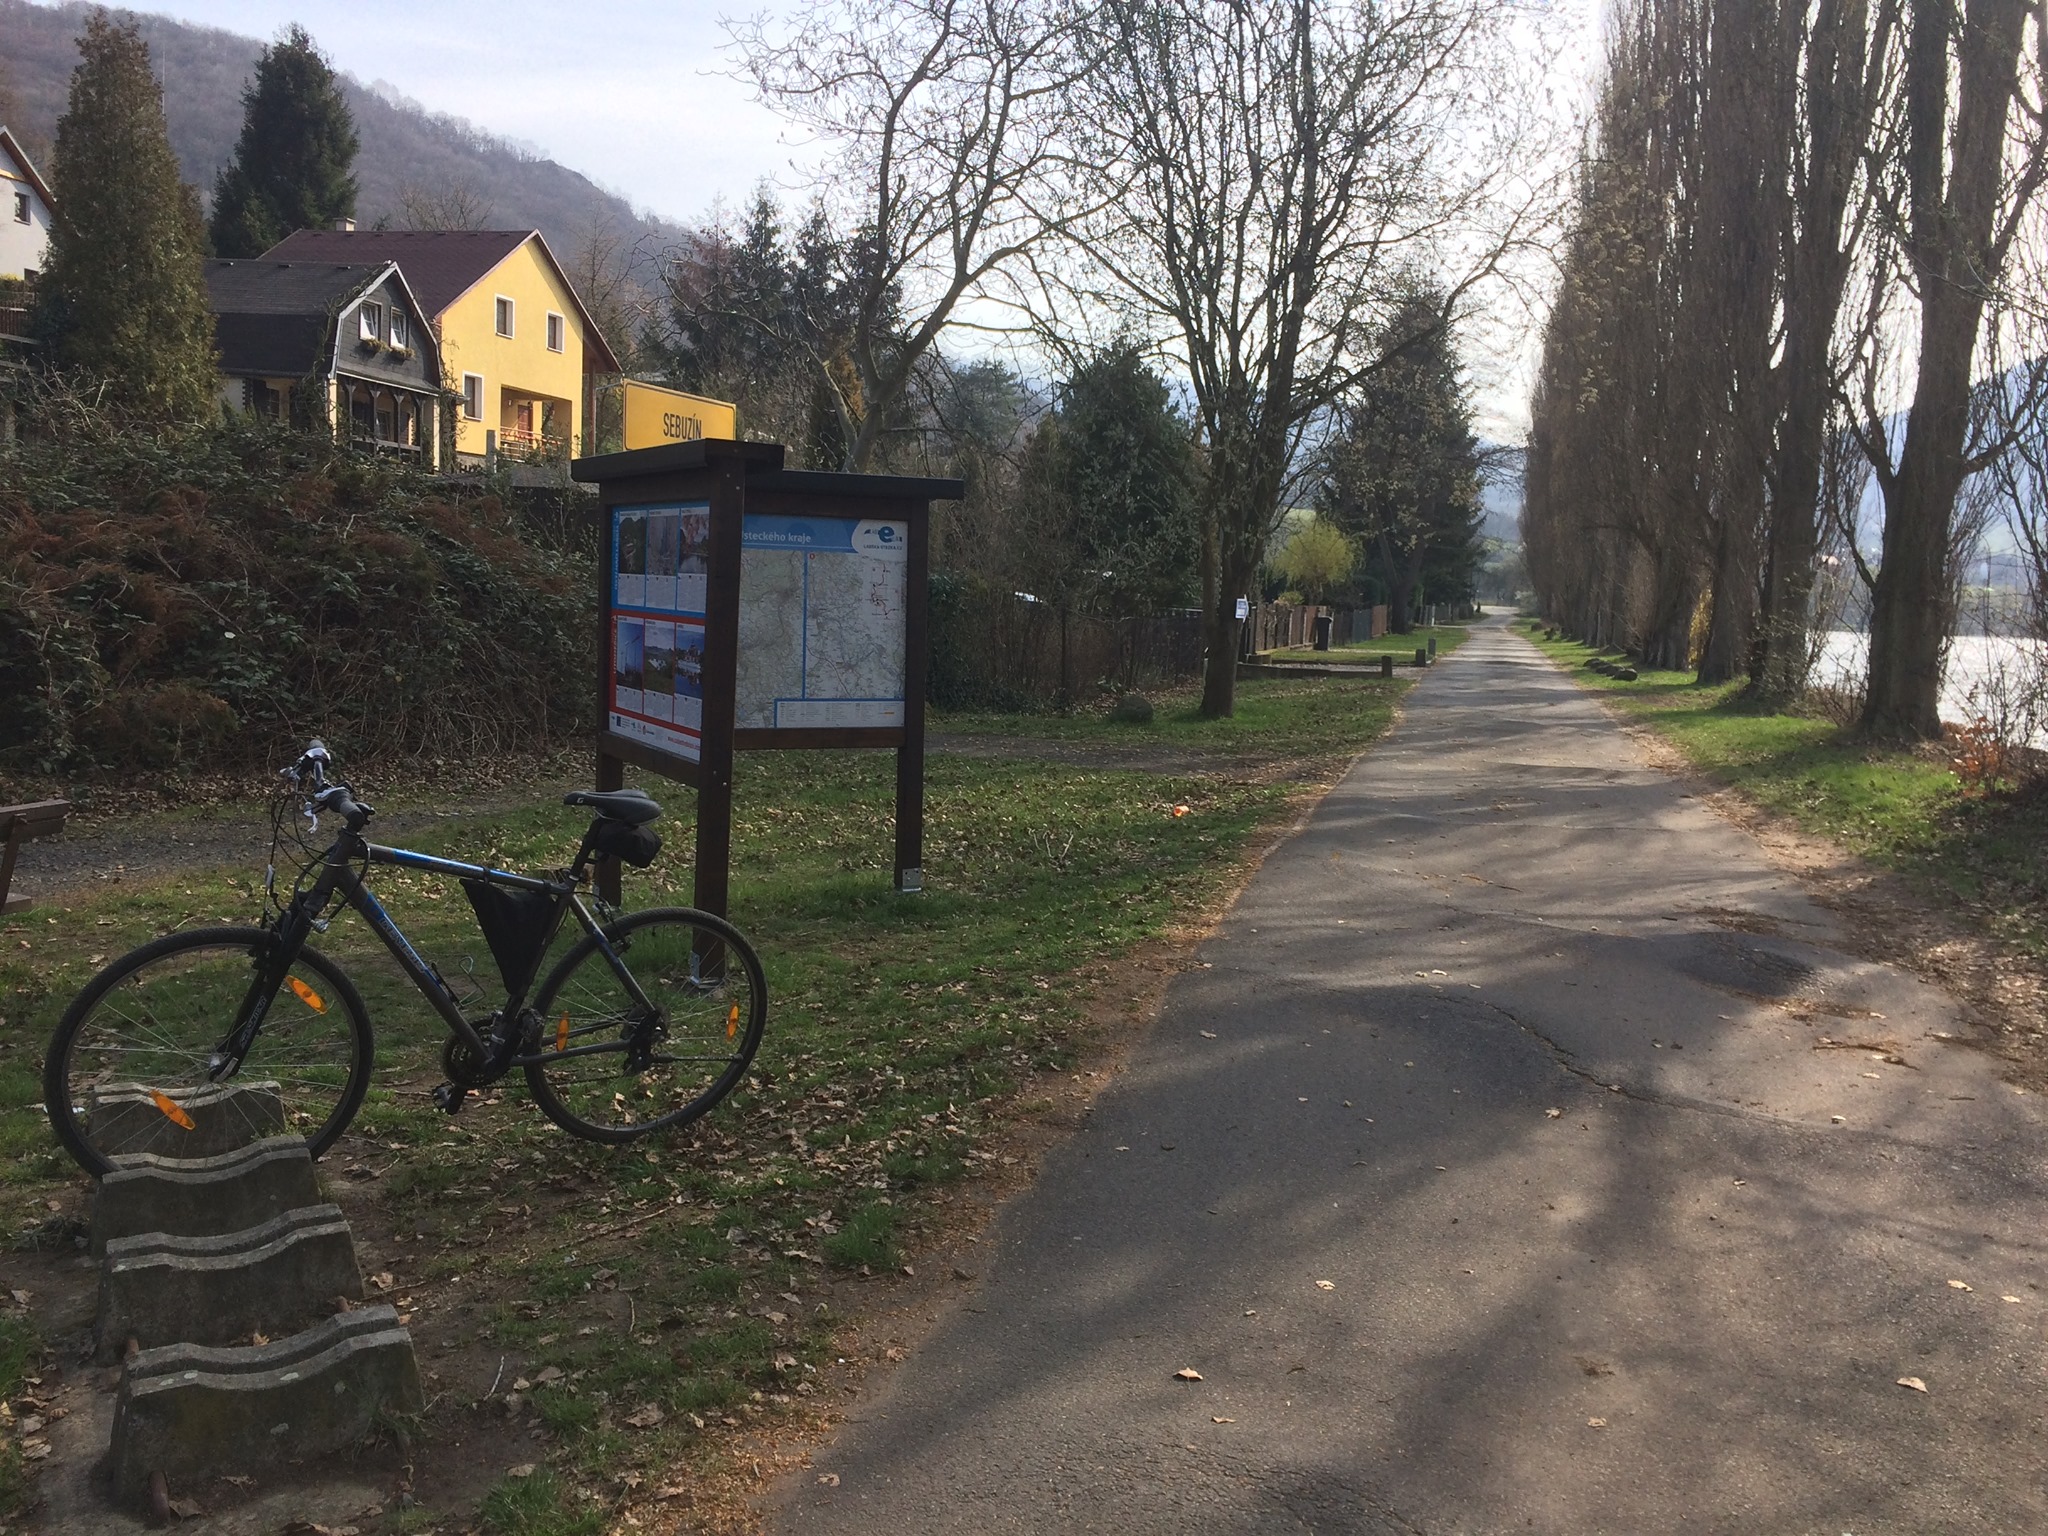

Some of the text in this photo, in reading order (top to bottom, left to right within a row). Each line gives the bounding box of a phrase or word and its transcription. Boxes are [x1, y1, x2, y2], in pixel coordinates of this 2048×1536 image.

[663, 412, 702, 440] SEBUZÍN
[741, 531, 812, 545] steckého kraje
